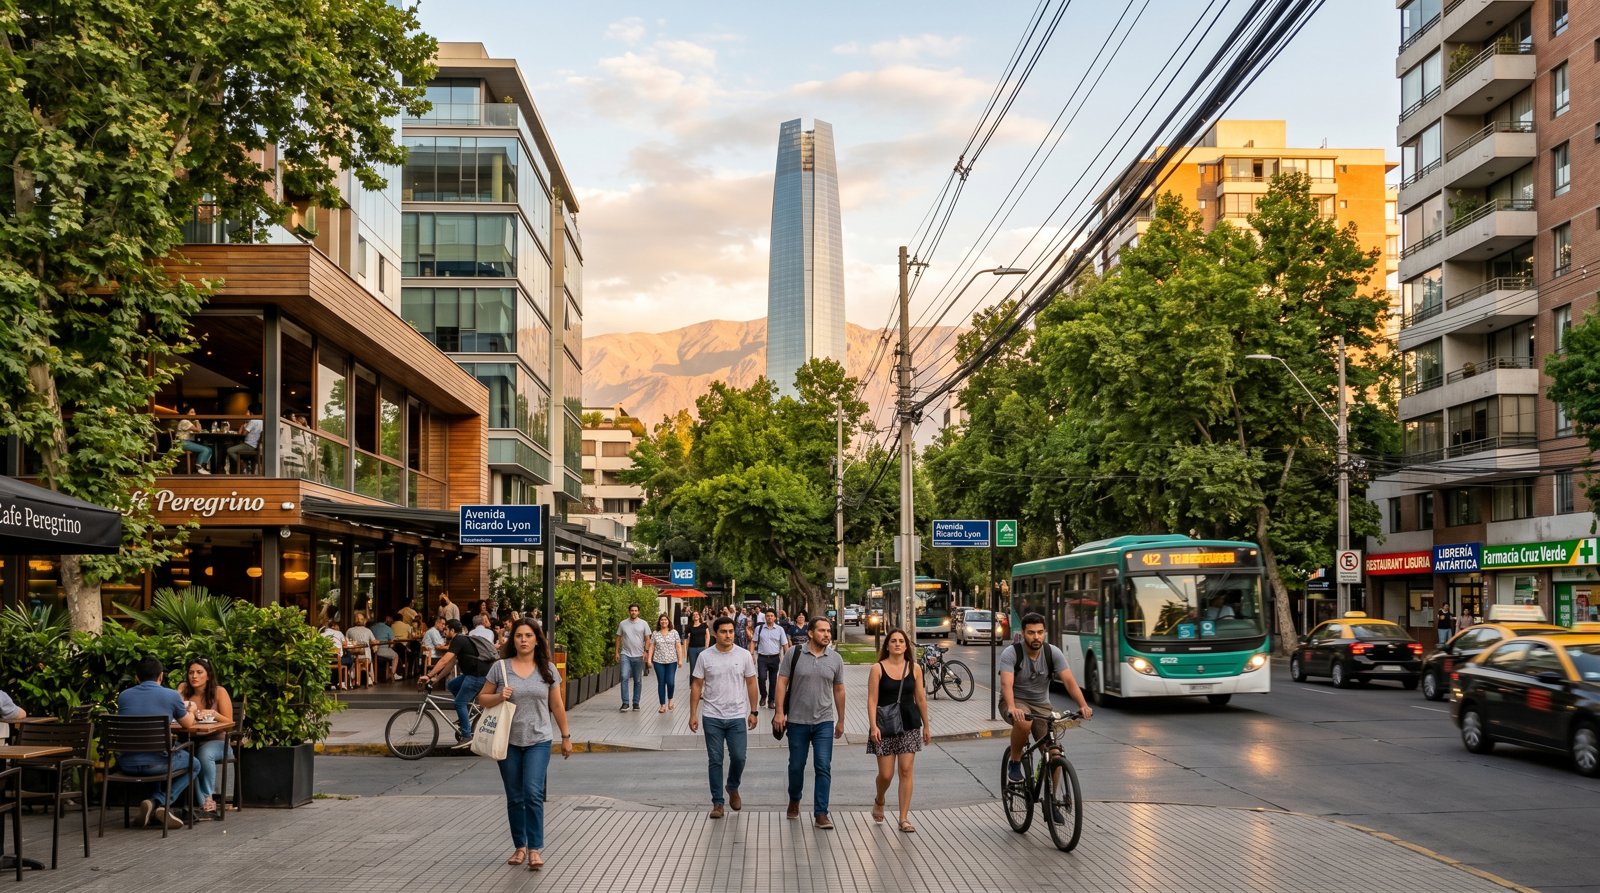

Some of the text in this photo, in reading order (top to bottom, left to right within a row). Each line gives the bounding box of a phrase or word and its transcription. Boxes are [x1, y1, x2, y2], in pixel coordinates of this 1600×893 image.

[155, 489, 265, 517] Peregrino
[0, 503, 81, 536] afe Peregrino
[465, 509, 506, 519] Avenida
[465, 520, 531, 532] Ricardo Lyon
[936, 530, 981, 539] Ricardo Lyon
[1438, 543, 1473, 559] LIBRERÍA
[1483, 544, 1567, 565] Farmacia Cruz Verde
[1142, 553, 1161, 566] 412
[1366, 556, 1430, 571] RESTAURANT LIGURIA
[1435, 557, 1478, 571] ANTÁRTICA
